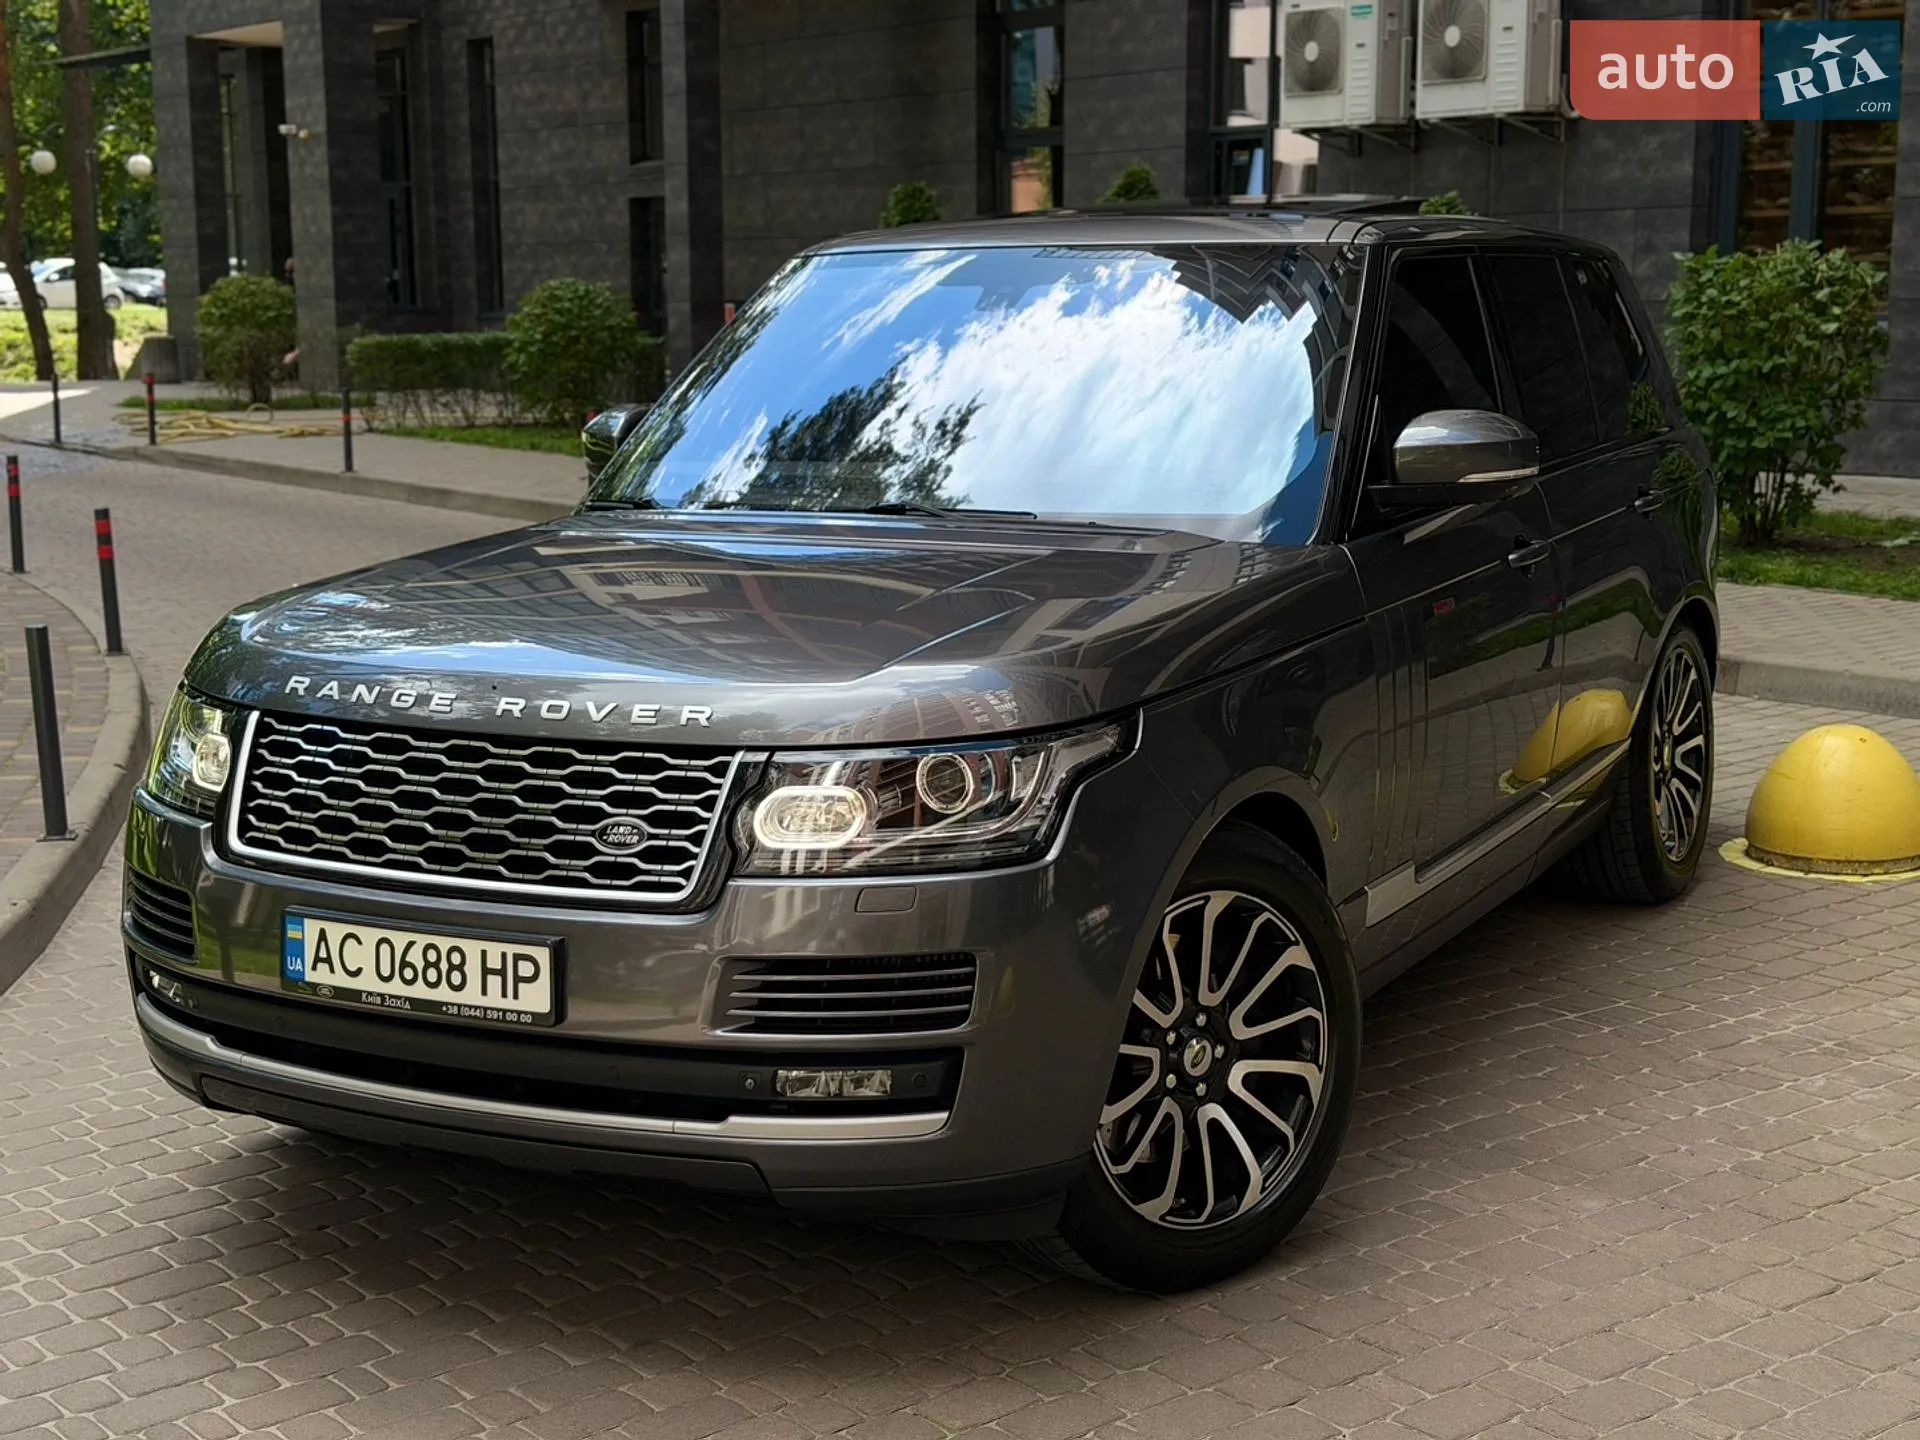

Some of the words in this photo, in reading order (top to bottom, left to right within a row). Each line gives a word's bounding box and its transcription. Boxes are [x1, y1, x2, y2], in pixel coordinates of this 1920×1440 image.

[285, 676, 457, 712] RANGE
[496, 697, 714, 728] ROVER
[606, 825, 632, 834] LAND
[606, 834, 640, 844] ROVER
[287, 955, 304, 972] UA
[310, 926, 364, 979] AC
[374, 936, 468, 993] 0688
[480, 948, 541, 1000] HP
[486, 1010, 503, 1020] 591
